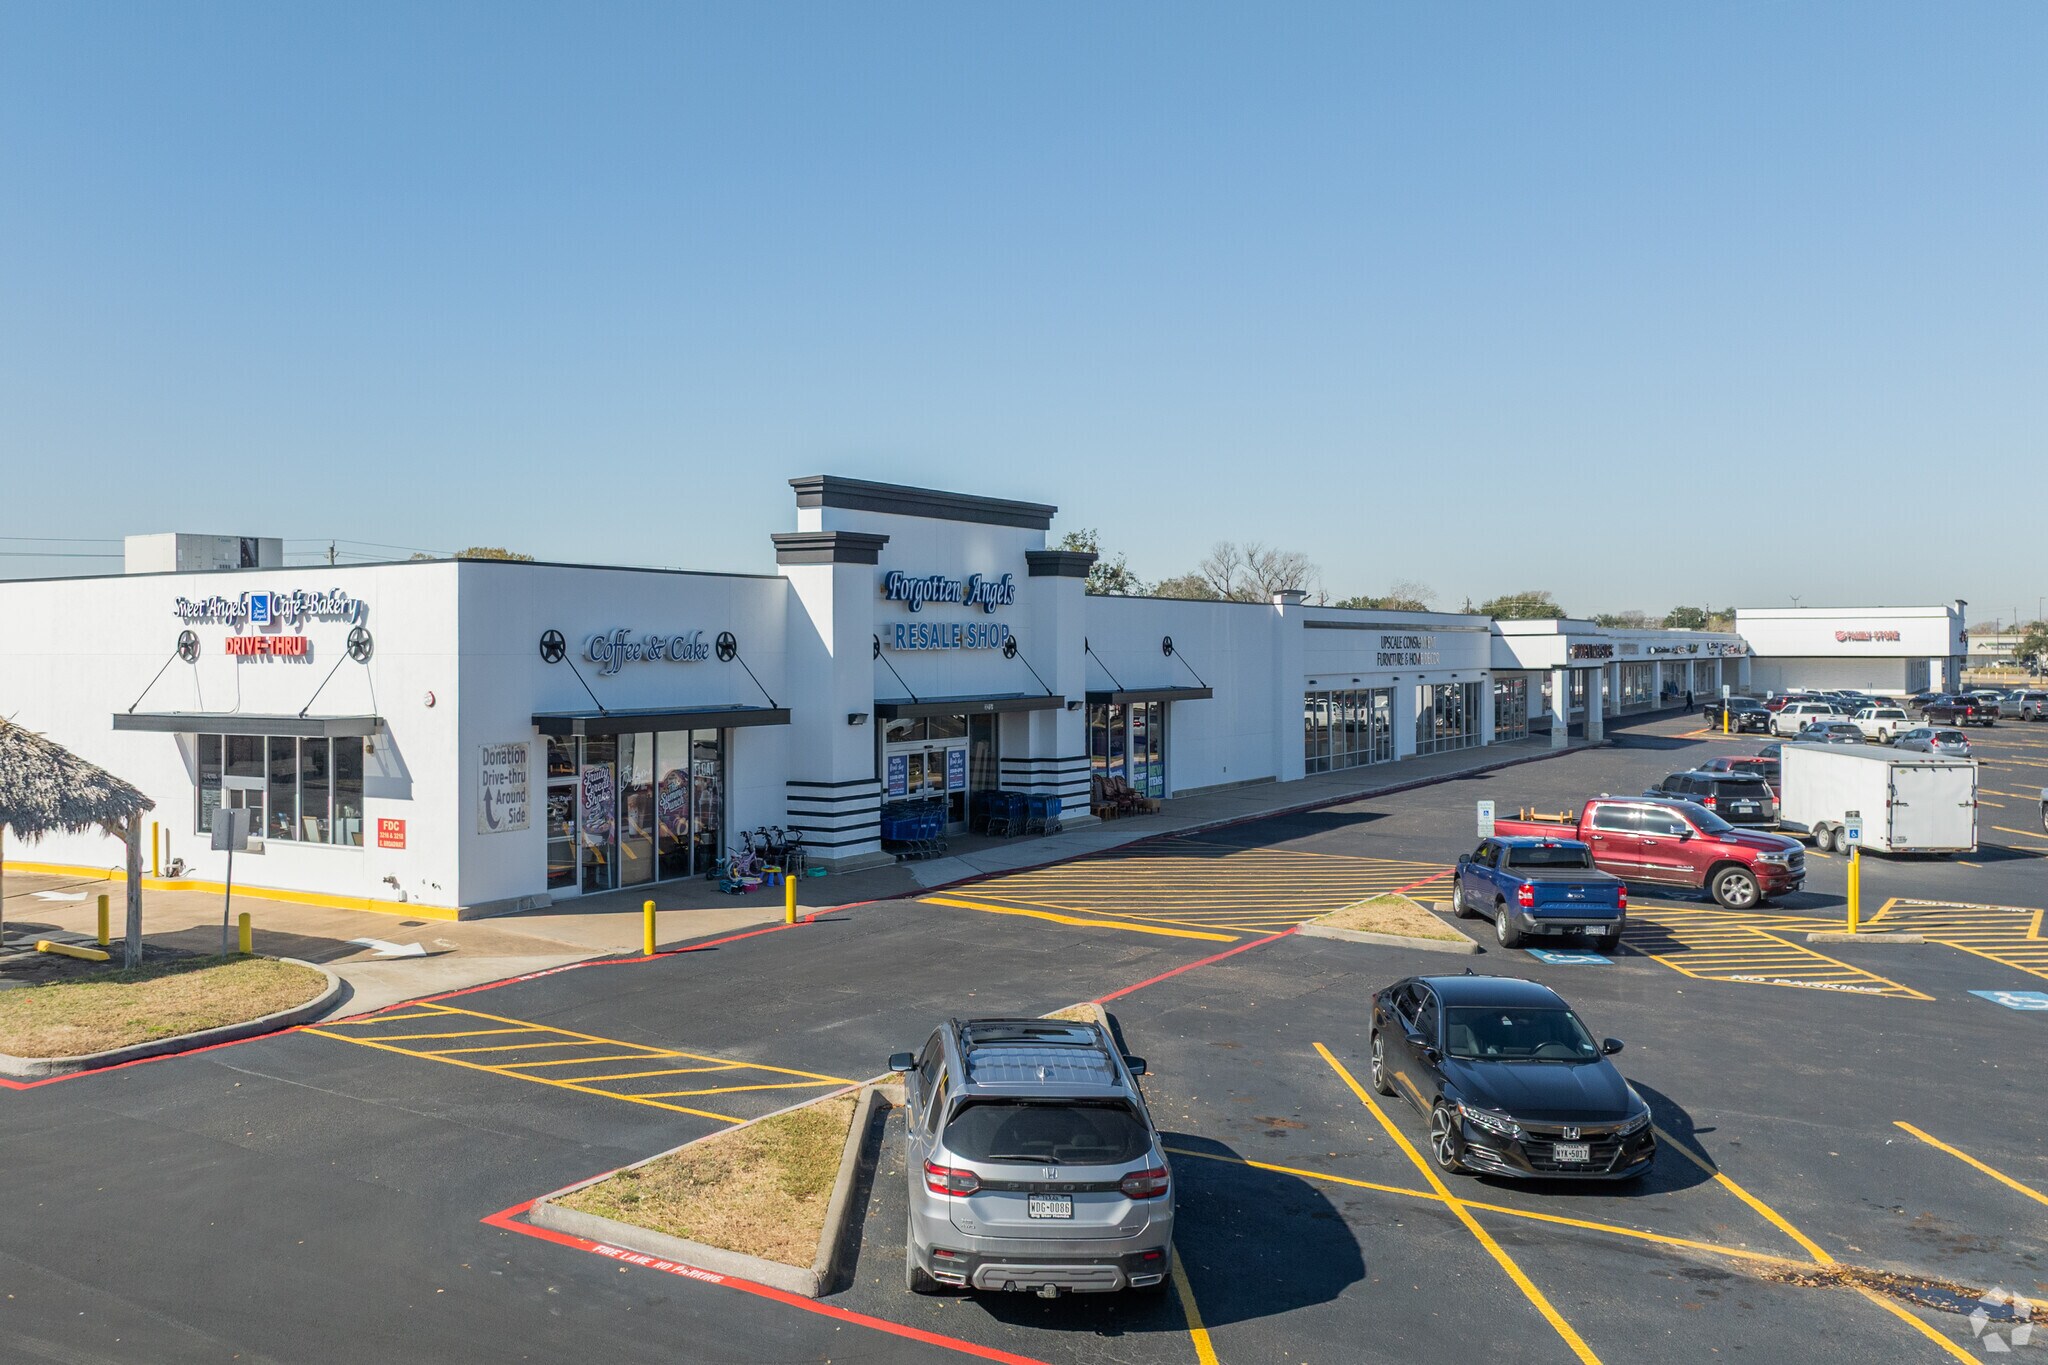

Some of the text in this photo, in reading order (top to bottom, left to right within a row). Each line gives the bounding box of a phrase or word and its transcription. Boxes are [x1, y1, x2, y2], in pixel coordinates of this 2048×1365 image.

[887, 570, 1015, 614] Forgotten Angels
[173, 595, 203, 619] Sweet
[204, 591, 249, 626] Angels
[225, 636, 304, 655] DRIVE-THRU
[895, 623, 1010, 650] RESALE SHOP
[1381, 635, 1403, 649] UPSCALE
[590, 629, 710, 674] Coffee & Cake
[482, 747, 526, 766] Donation
[482, 768, 526, 786] Drive-thru
[583, 767, 609, 785] Fruity
[496, 786, 526, 805] Around
[584, 777, 611, 796] Cereal
[660, 786, 687, 806] Summer
[585, 790, 611, 809] Shake
[508, 806, 526, 824] Side
[383, 820, 400, 831] FDC
[1730, 974, 1882, 993] NO PARKING
[1007, 1183, 1095, 1191] PILOT
[592, 1245, 725, 1283] FIRE LANE NO PARKING
